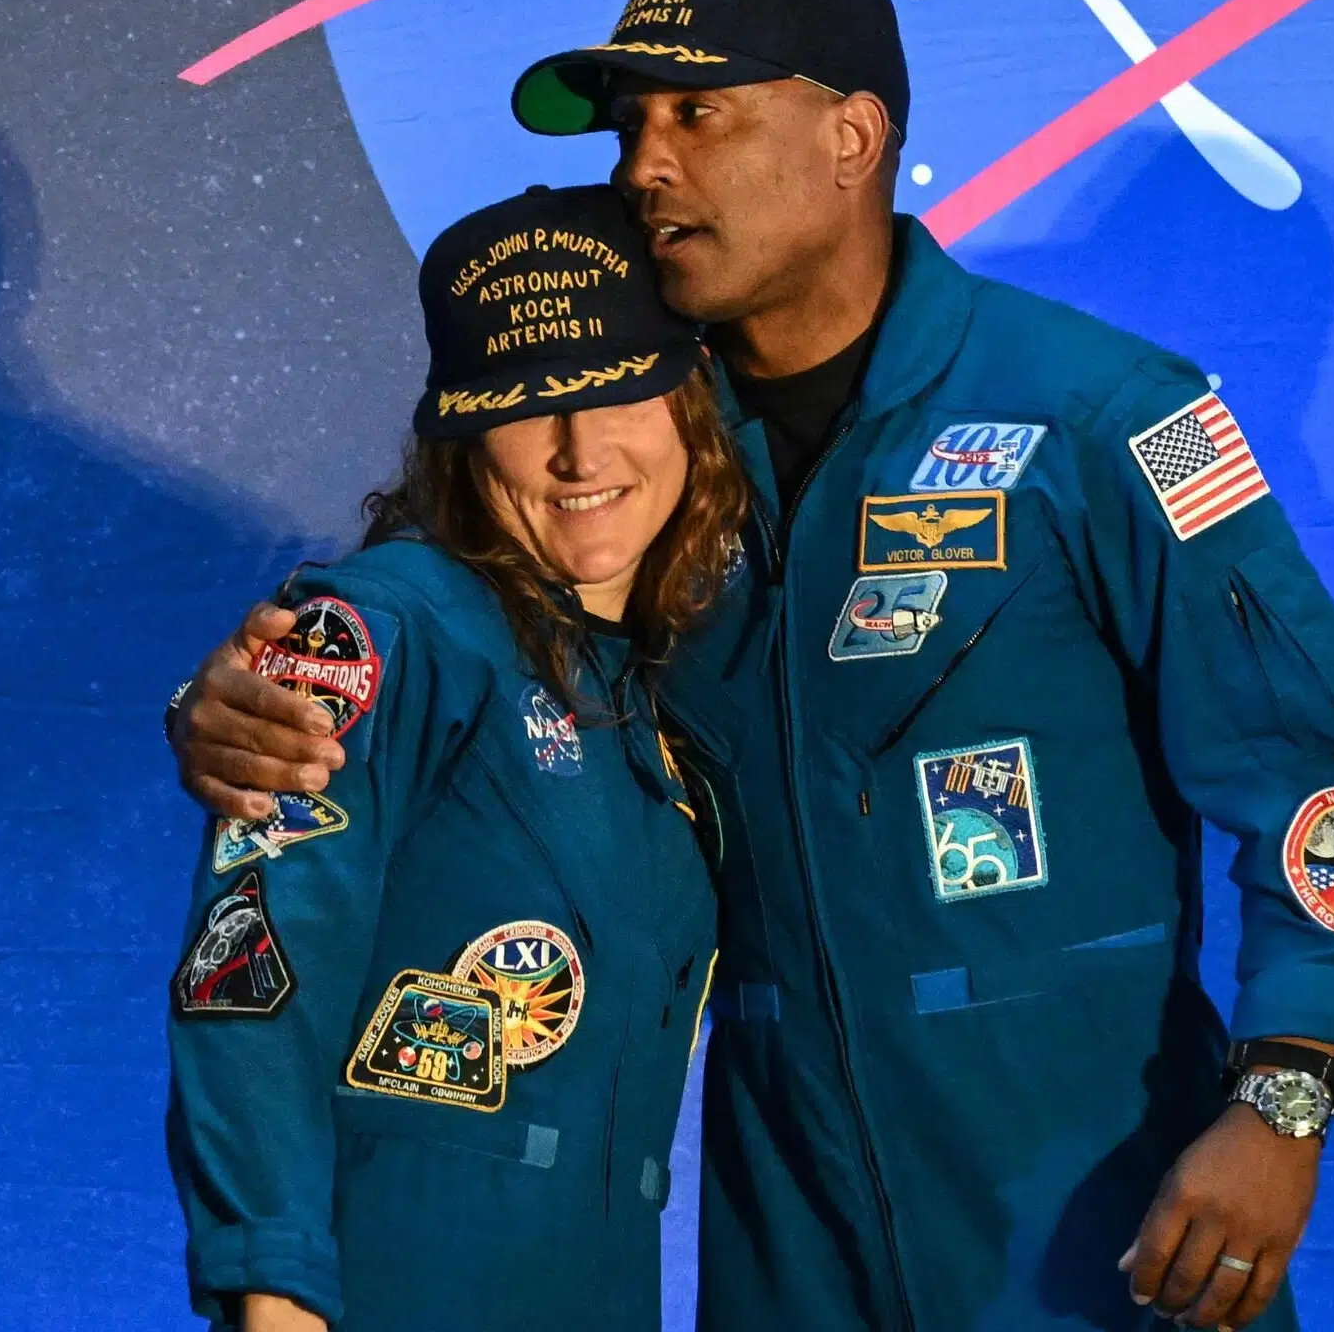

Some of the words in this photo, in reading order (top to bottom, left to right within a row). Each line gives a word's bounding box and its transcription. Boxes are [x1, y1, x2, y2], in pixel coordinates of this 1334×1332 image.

[676, 7, 693, 26] II
[451, 259, 487, 297] U.S.S.
[487, 231, 529, 267] JOHN
[534, 228, 549, 252] P.
[552, 231, 629, 279] MURTHA
[479, 268, 603, 304] ASTRONAUT
[510, 296, 571, 324] KOCH
[486, 319, 581, 356] ARTEMIS
[589, 318, 604, 337] II
[958, 452, 990, 464] DAYS
[886, 548, 924, 563] VICTOR
[931, 547, 974, 560] GLOVER
[256, 645, 292, 677] FLIGHT
[295, 660, 373, 701] OPERATIONS
[524, 715, 581, 742] NASA
[937, 822, 1007, 890] 65
[1296, 880, 1316, 905] THE
[495, 939, 550, 970] LXI
[417, 976, 479, 997] КОНОНЕНКО
[359, 987, 401, 1062] SAINT-JACQUES
[492, 1007, 501, 1043] HAGUE
[416, 1048, 448, 1081] 59
[492, 1055, 501, 1085] KOCH
